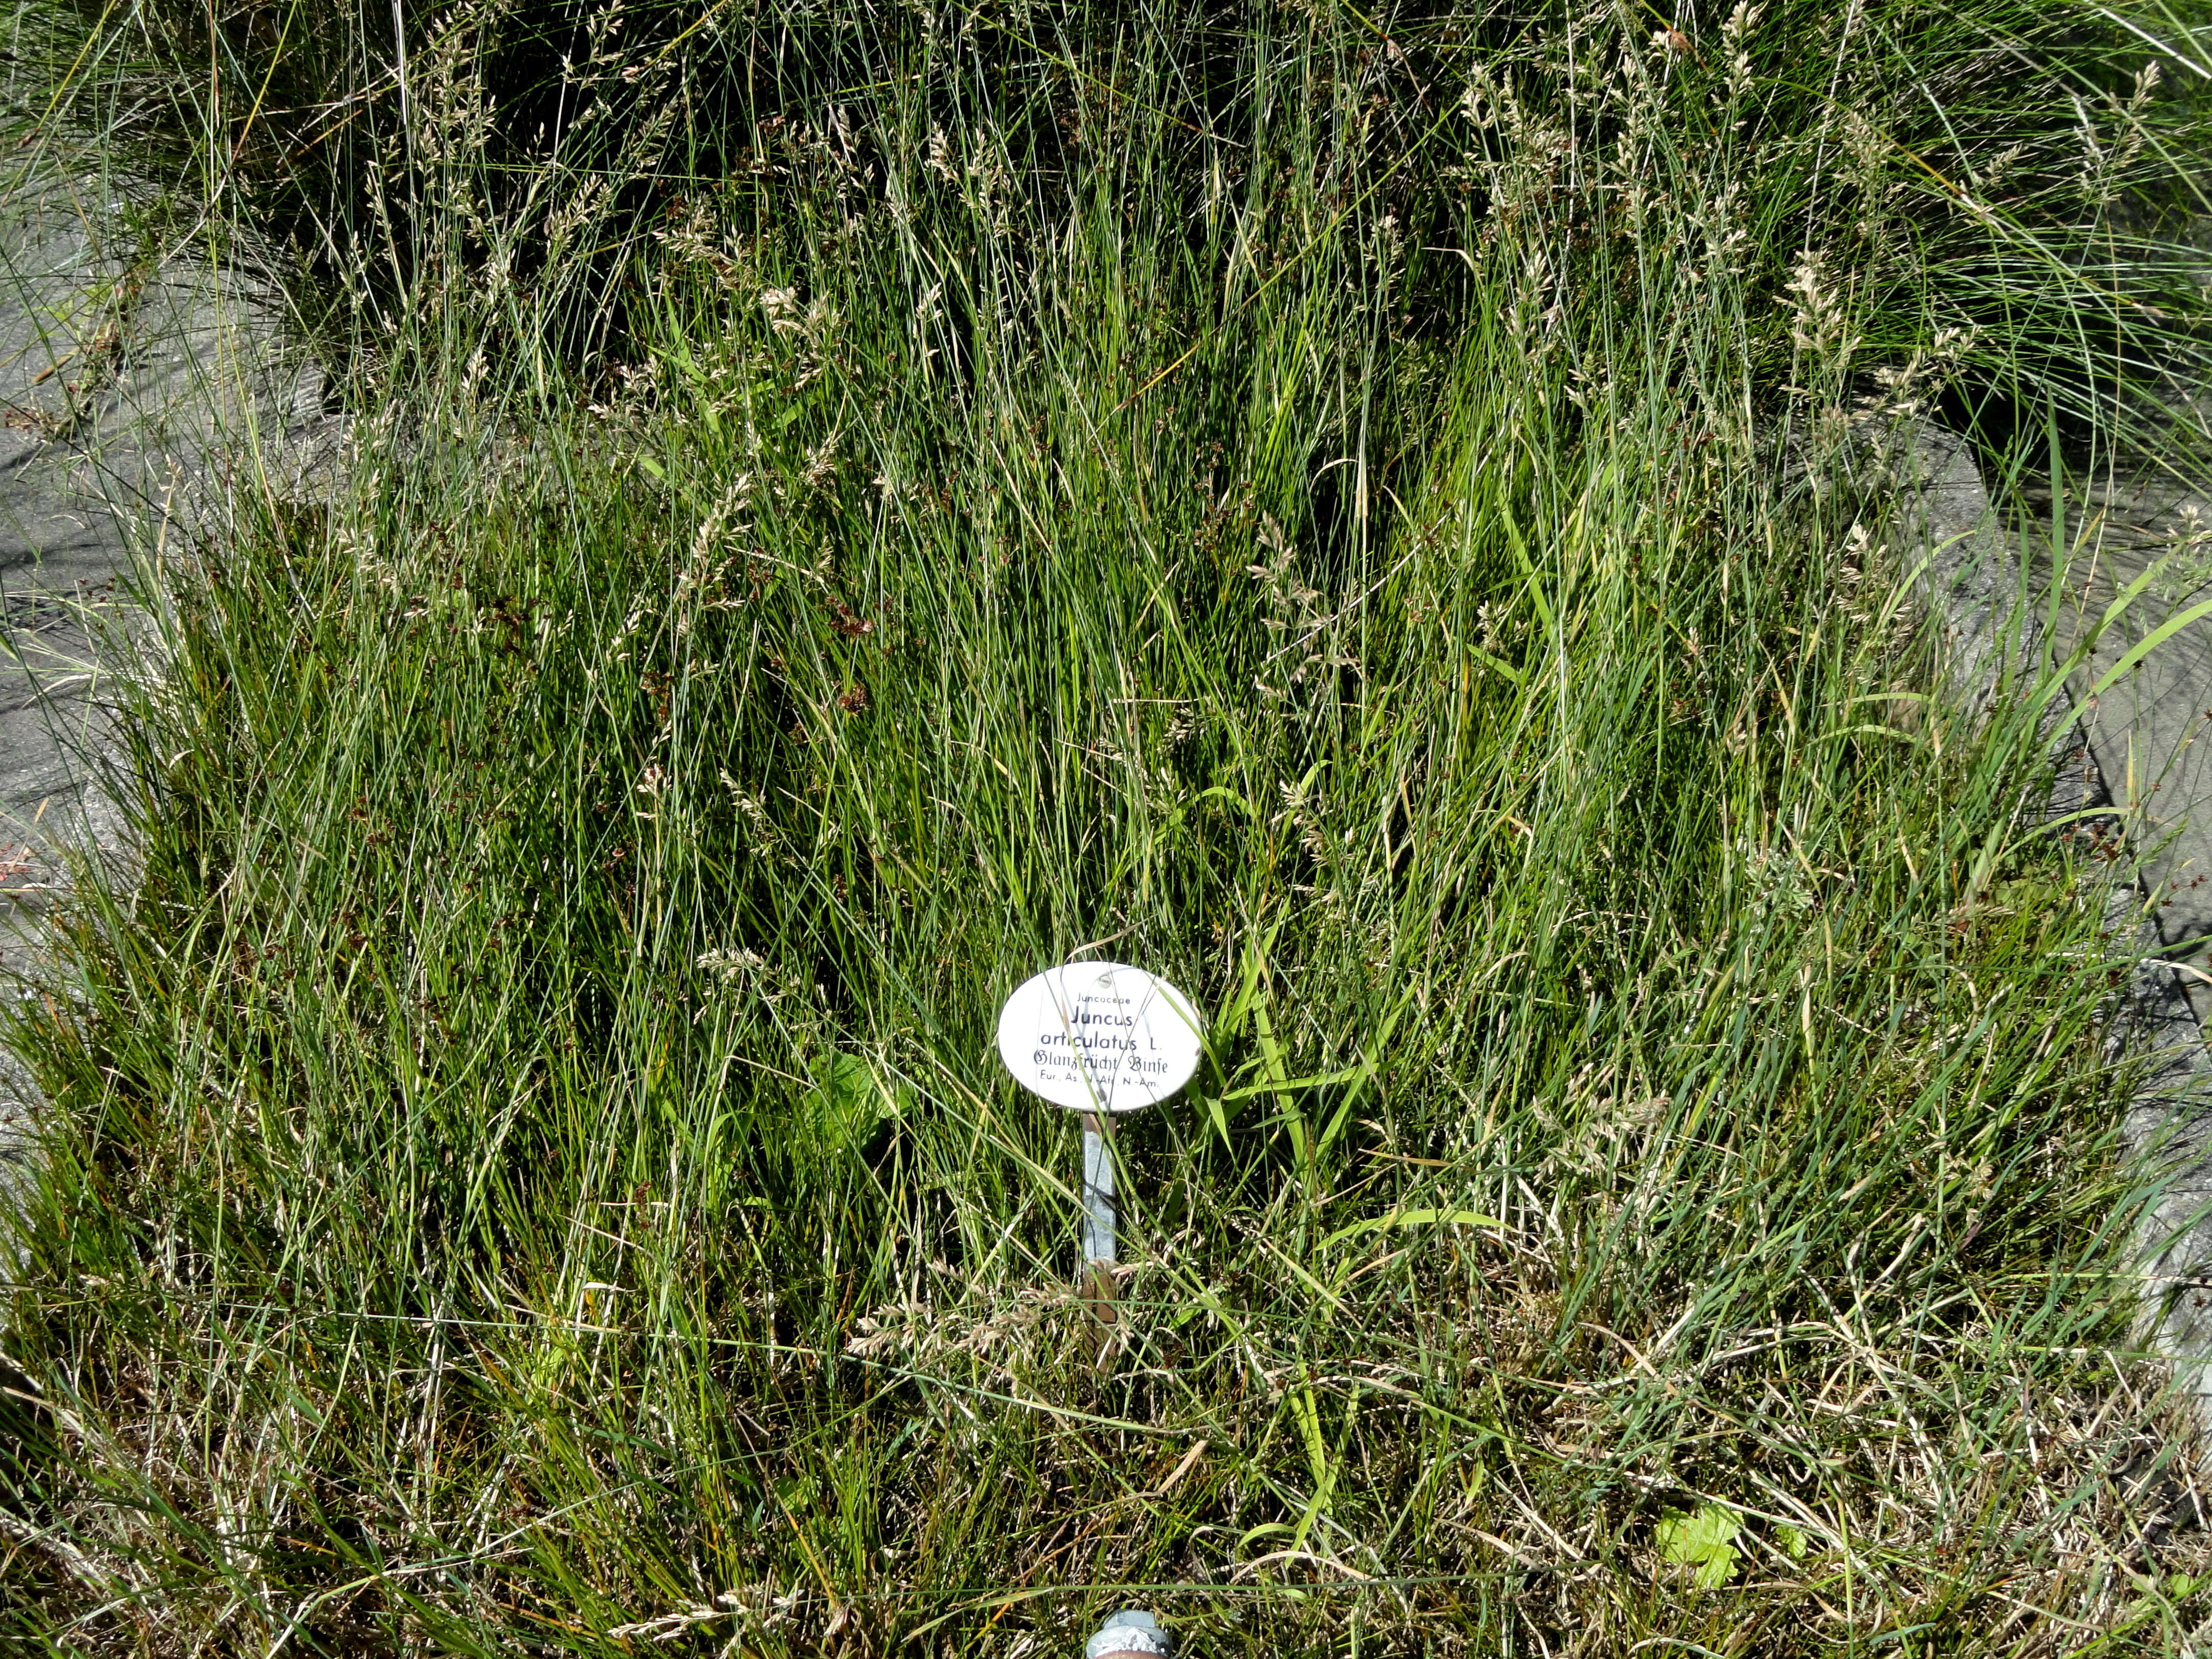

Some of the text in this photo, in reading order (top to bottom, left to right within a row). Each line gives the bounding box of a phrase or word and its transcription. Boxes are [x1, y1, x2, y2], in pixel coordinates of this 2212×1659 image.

[1077, 992, 1131, 1004] Juncaceae
[1071, 1006, 1133, 1026] Juncus
[1040, 1031, 1162, 1050] articulatus L.
